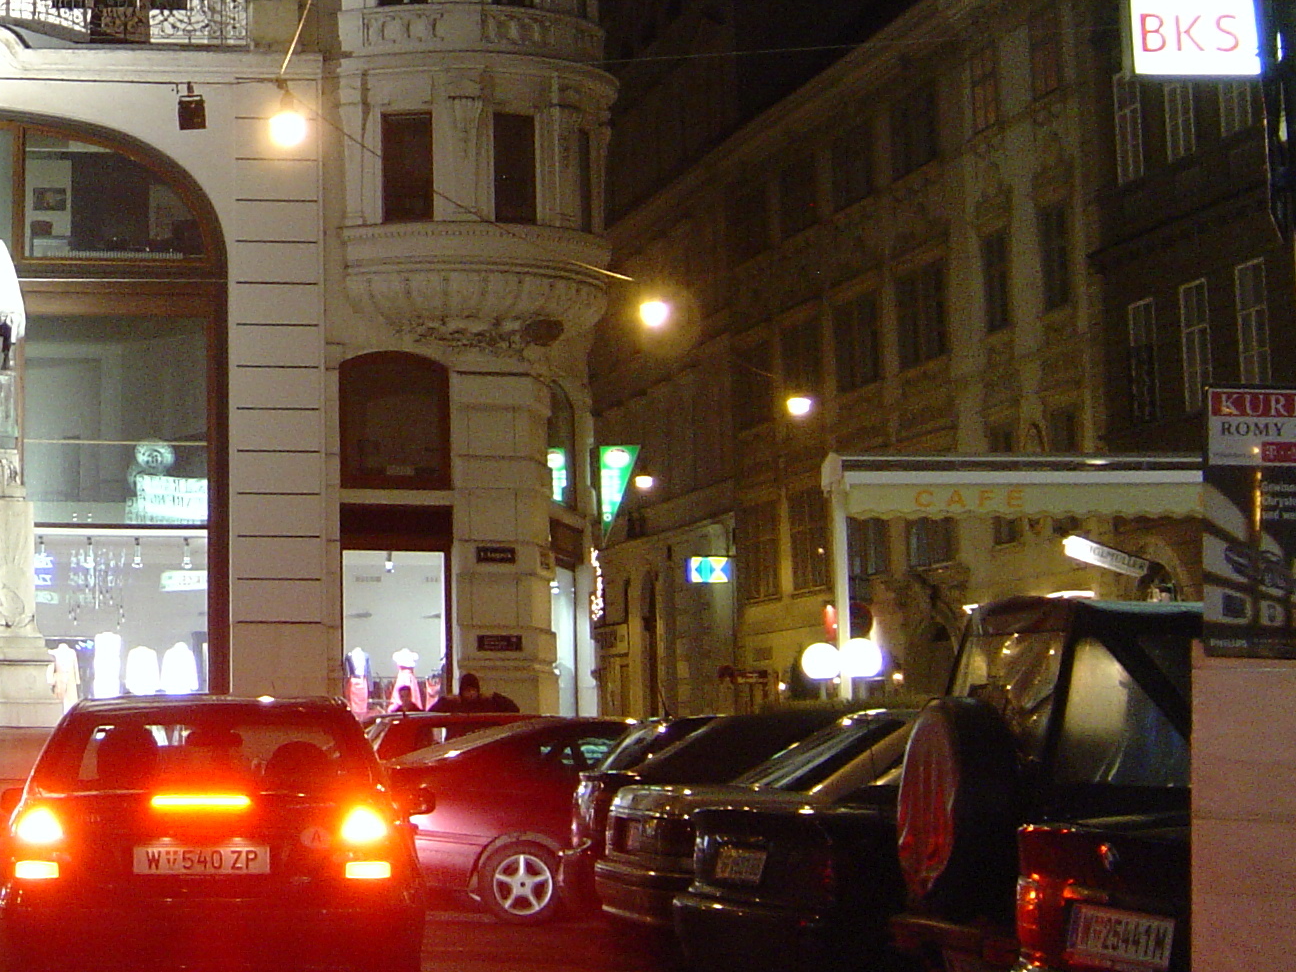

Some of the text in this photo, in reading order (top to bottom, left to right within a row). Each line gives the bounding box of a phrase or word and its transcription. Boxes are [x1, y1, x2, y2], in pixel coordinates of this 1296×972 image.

[1140, 13, 1239, 52] BKS
[1221, 421, 1284, 437] ROMY
[146, 849, 258, 870] W 540 ZP
